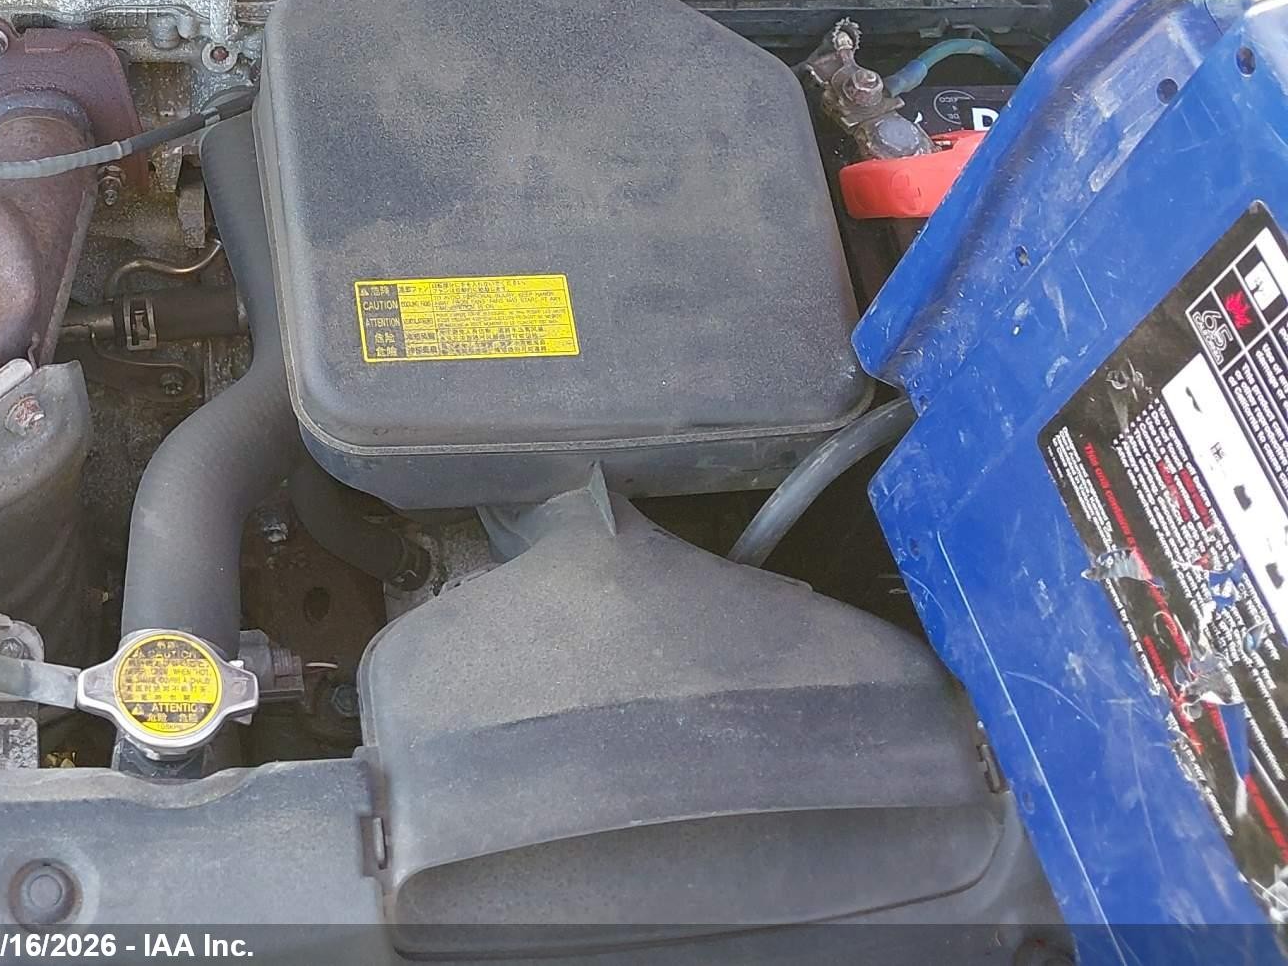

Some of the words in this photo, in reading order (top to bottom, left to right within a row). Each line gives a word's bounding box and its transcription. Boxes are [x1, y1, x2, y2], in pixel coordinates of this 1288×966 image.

[363, 300, 398, 310] CAUTION
[365, 318, 401, 327] ATTENTION
[1202, 310, 1233, 352] 65
[1255, 350, 1279, 388] damage
[1262, 343, 1275, 362] Use
[1273, 364, 1282, 374] of
[1235, 370, 1243, 380] or
[1241, 381, 1257, 406] other
[1242, 363, 1255, 383] This
[1249, 385, 1275, 422] product
[1134, 428, 1147, 452] Then
[1145, 416, 1156, 435] Use
[1154, 436, 1162, 445] in
[1151, 410, 1160, 424] Do
[1158, 426, 1170, 442] not
[1167, 442, 1183, 470] touch
[1228, 376, 1238, 386] of
[1234, 386, 1260, 431] California
[1257, 431, 1266, 442] to
[1263, 443, 1281, 472] cause
[1061, 426, 1080, 461] Designed
[1116, 447, 1129, 467] After
[1121, 441, 1139, 472] Always
[1127, 435, 1140, 456] After
[1139, 423, 1161, 462] Connect
[1158, 404, 1170, 425] Turn
[1168, 426, 1188, 461] ignition
[1186, 462, 1196, 475] off
[1193, 475, 1211, 507] before
[1079, 463, 1088, 477] and
[1066, 452, 1092, 494] Automotive,
[1089, 496, 1104, 525] Kansas
[1083, 479, 1108, 520] engineered
[1085, 443, 1098, 466] This
[1095, 468, 1109, 488] unit
[1105, 490, 1130, 534] contains
